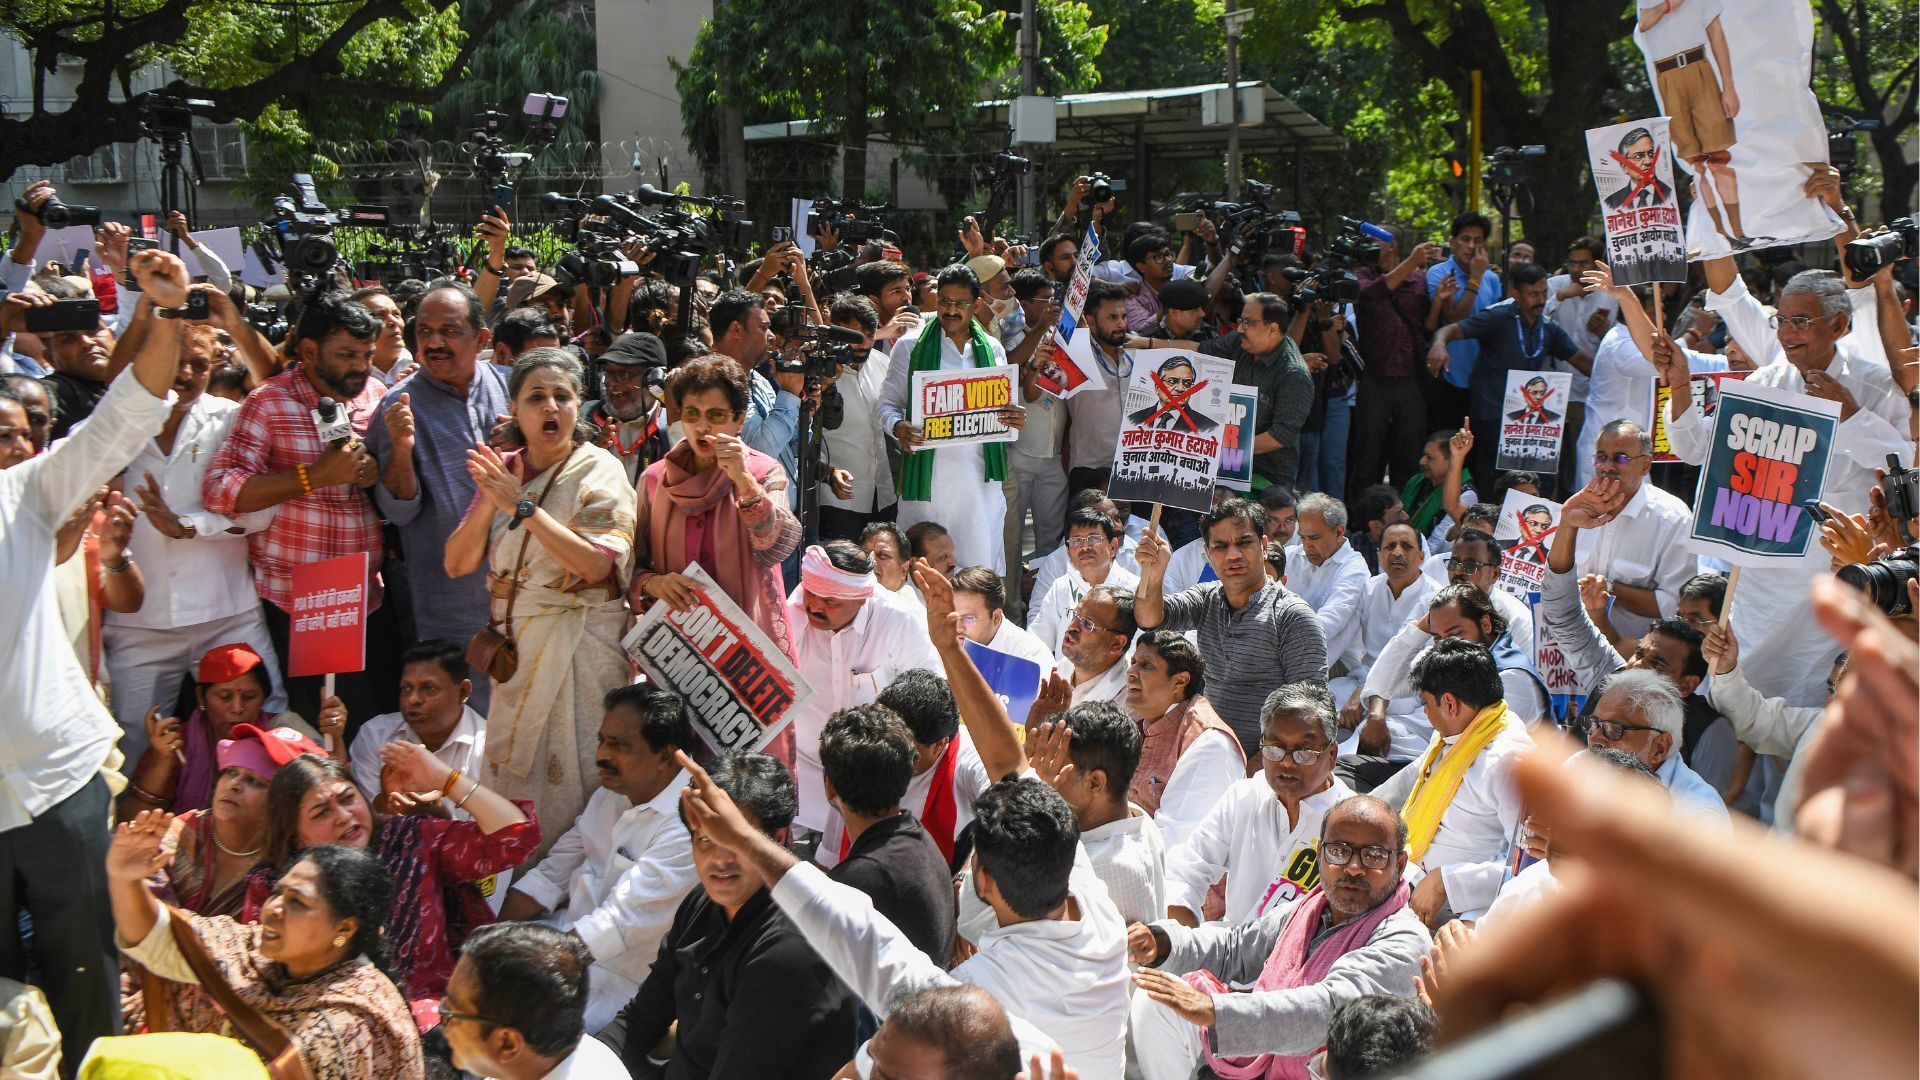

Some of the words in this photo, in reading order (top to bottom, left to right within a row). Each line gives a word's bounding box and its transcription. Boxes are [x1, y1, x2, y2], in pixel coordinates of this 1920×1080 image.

[1607, 210, 1637, 232] ज्ञानेश
[1611, 233, 1638, 252] चुनाव
[926, 384, 964, 414] FAIR
[966, 378, 1009, 409] VOTES
[924, 416, 953, 439] FREE
[1726, 413, 1817, 465] SCRAP
[1122, 426, 1153, 448] ज्ञानेश
[1154, 430, 1185, 449] कुमार
[1186, 435, 1218, 458] हटाओ
[1122, 451, 1148, 466] चुनाव
[1148, 450, 1178, 465] आयोग
[1180, 457, 1210, 474] बचाओ
[1730, 452, 1798, 505] SIR
[1711, 487, 1803, 543] NOW
[1513, 560, 1537, 577] कुमार
[1507, 575, 1529, 588] आयोग
[1539, 648, 1565, 669] MODI
[643, 624, 761, 749] DEMOCRACY
[720, 644, 792, 725] DELETE
[1547, 668, 1579, 689] CHOR
